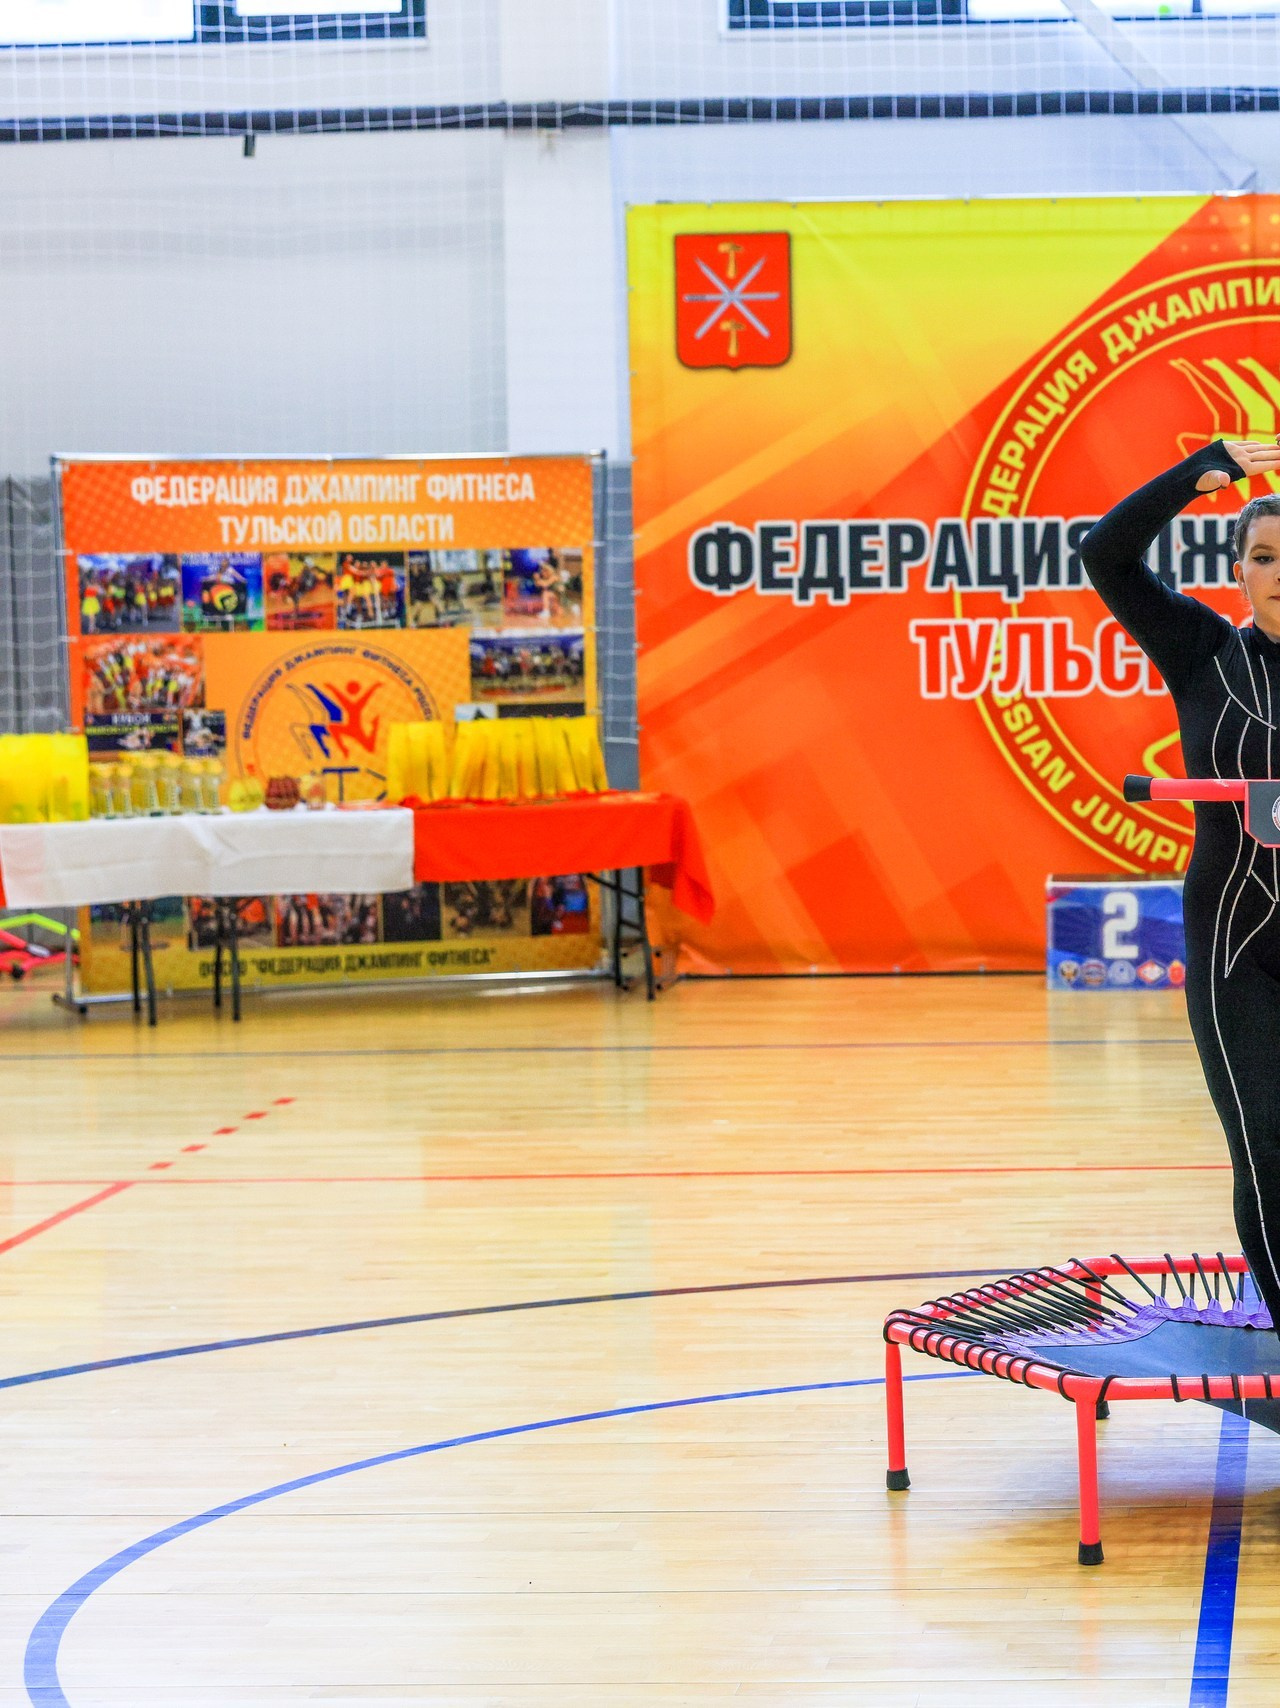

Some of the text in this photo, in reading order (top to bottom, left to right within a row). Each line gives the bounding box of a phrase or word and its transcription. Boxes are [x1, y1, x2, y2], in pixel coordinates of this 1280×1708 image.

[981, 348, 1098, 520] ДЕРАЦИЯ
[130, 472, 536, 507] ФЕДЕРАЦИЯ ДЖАМПИНГ ФИТНЕСА
[218, 510, 455, 545] ТУЛЬСКОЙ ОБЛАСТИ
[1070, 794, 1190, 873] JUMPI
[1102, 891, 1139, 959] 2
